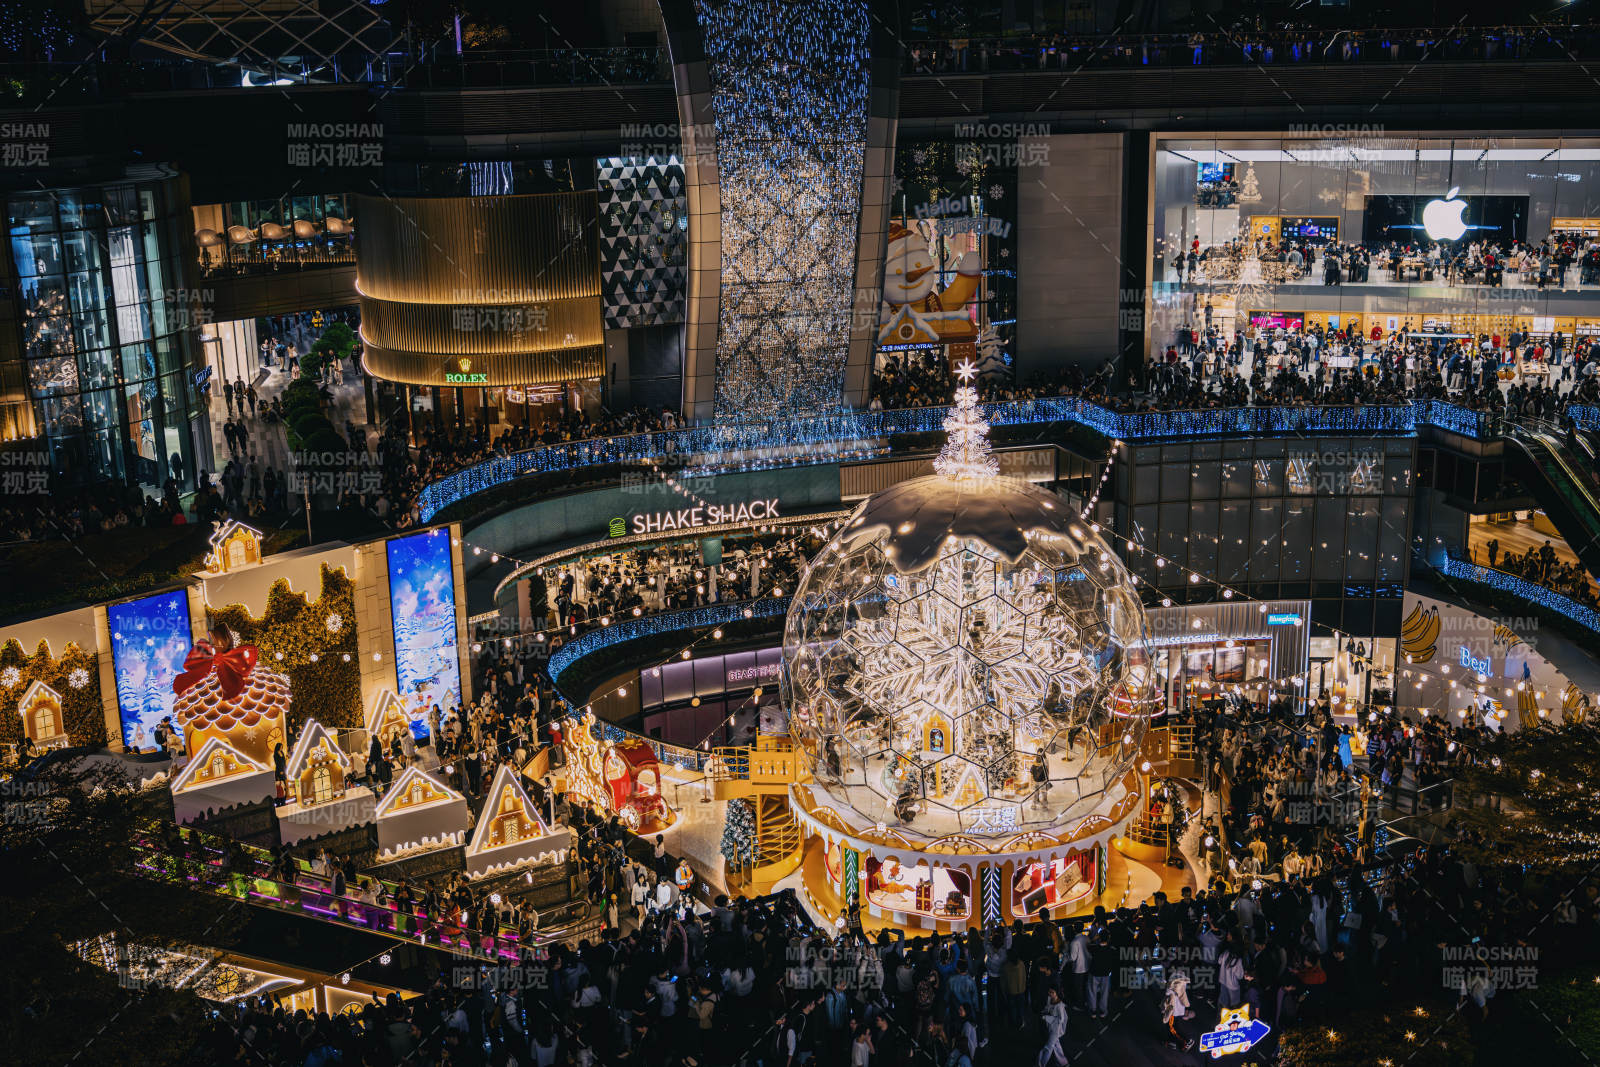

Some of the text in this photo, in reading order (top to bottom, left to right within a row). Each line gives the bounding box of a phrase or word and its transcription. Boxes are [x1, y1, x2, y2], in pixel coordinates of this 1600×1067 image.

[446, 373, 488, 383] ROLEX
[632, 507, 704, 534] SHAKE
[707, 498, 780, 525] SHACK
